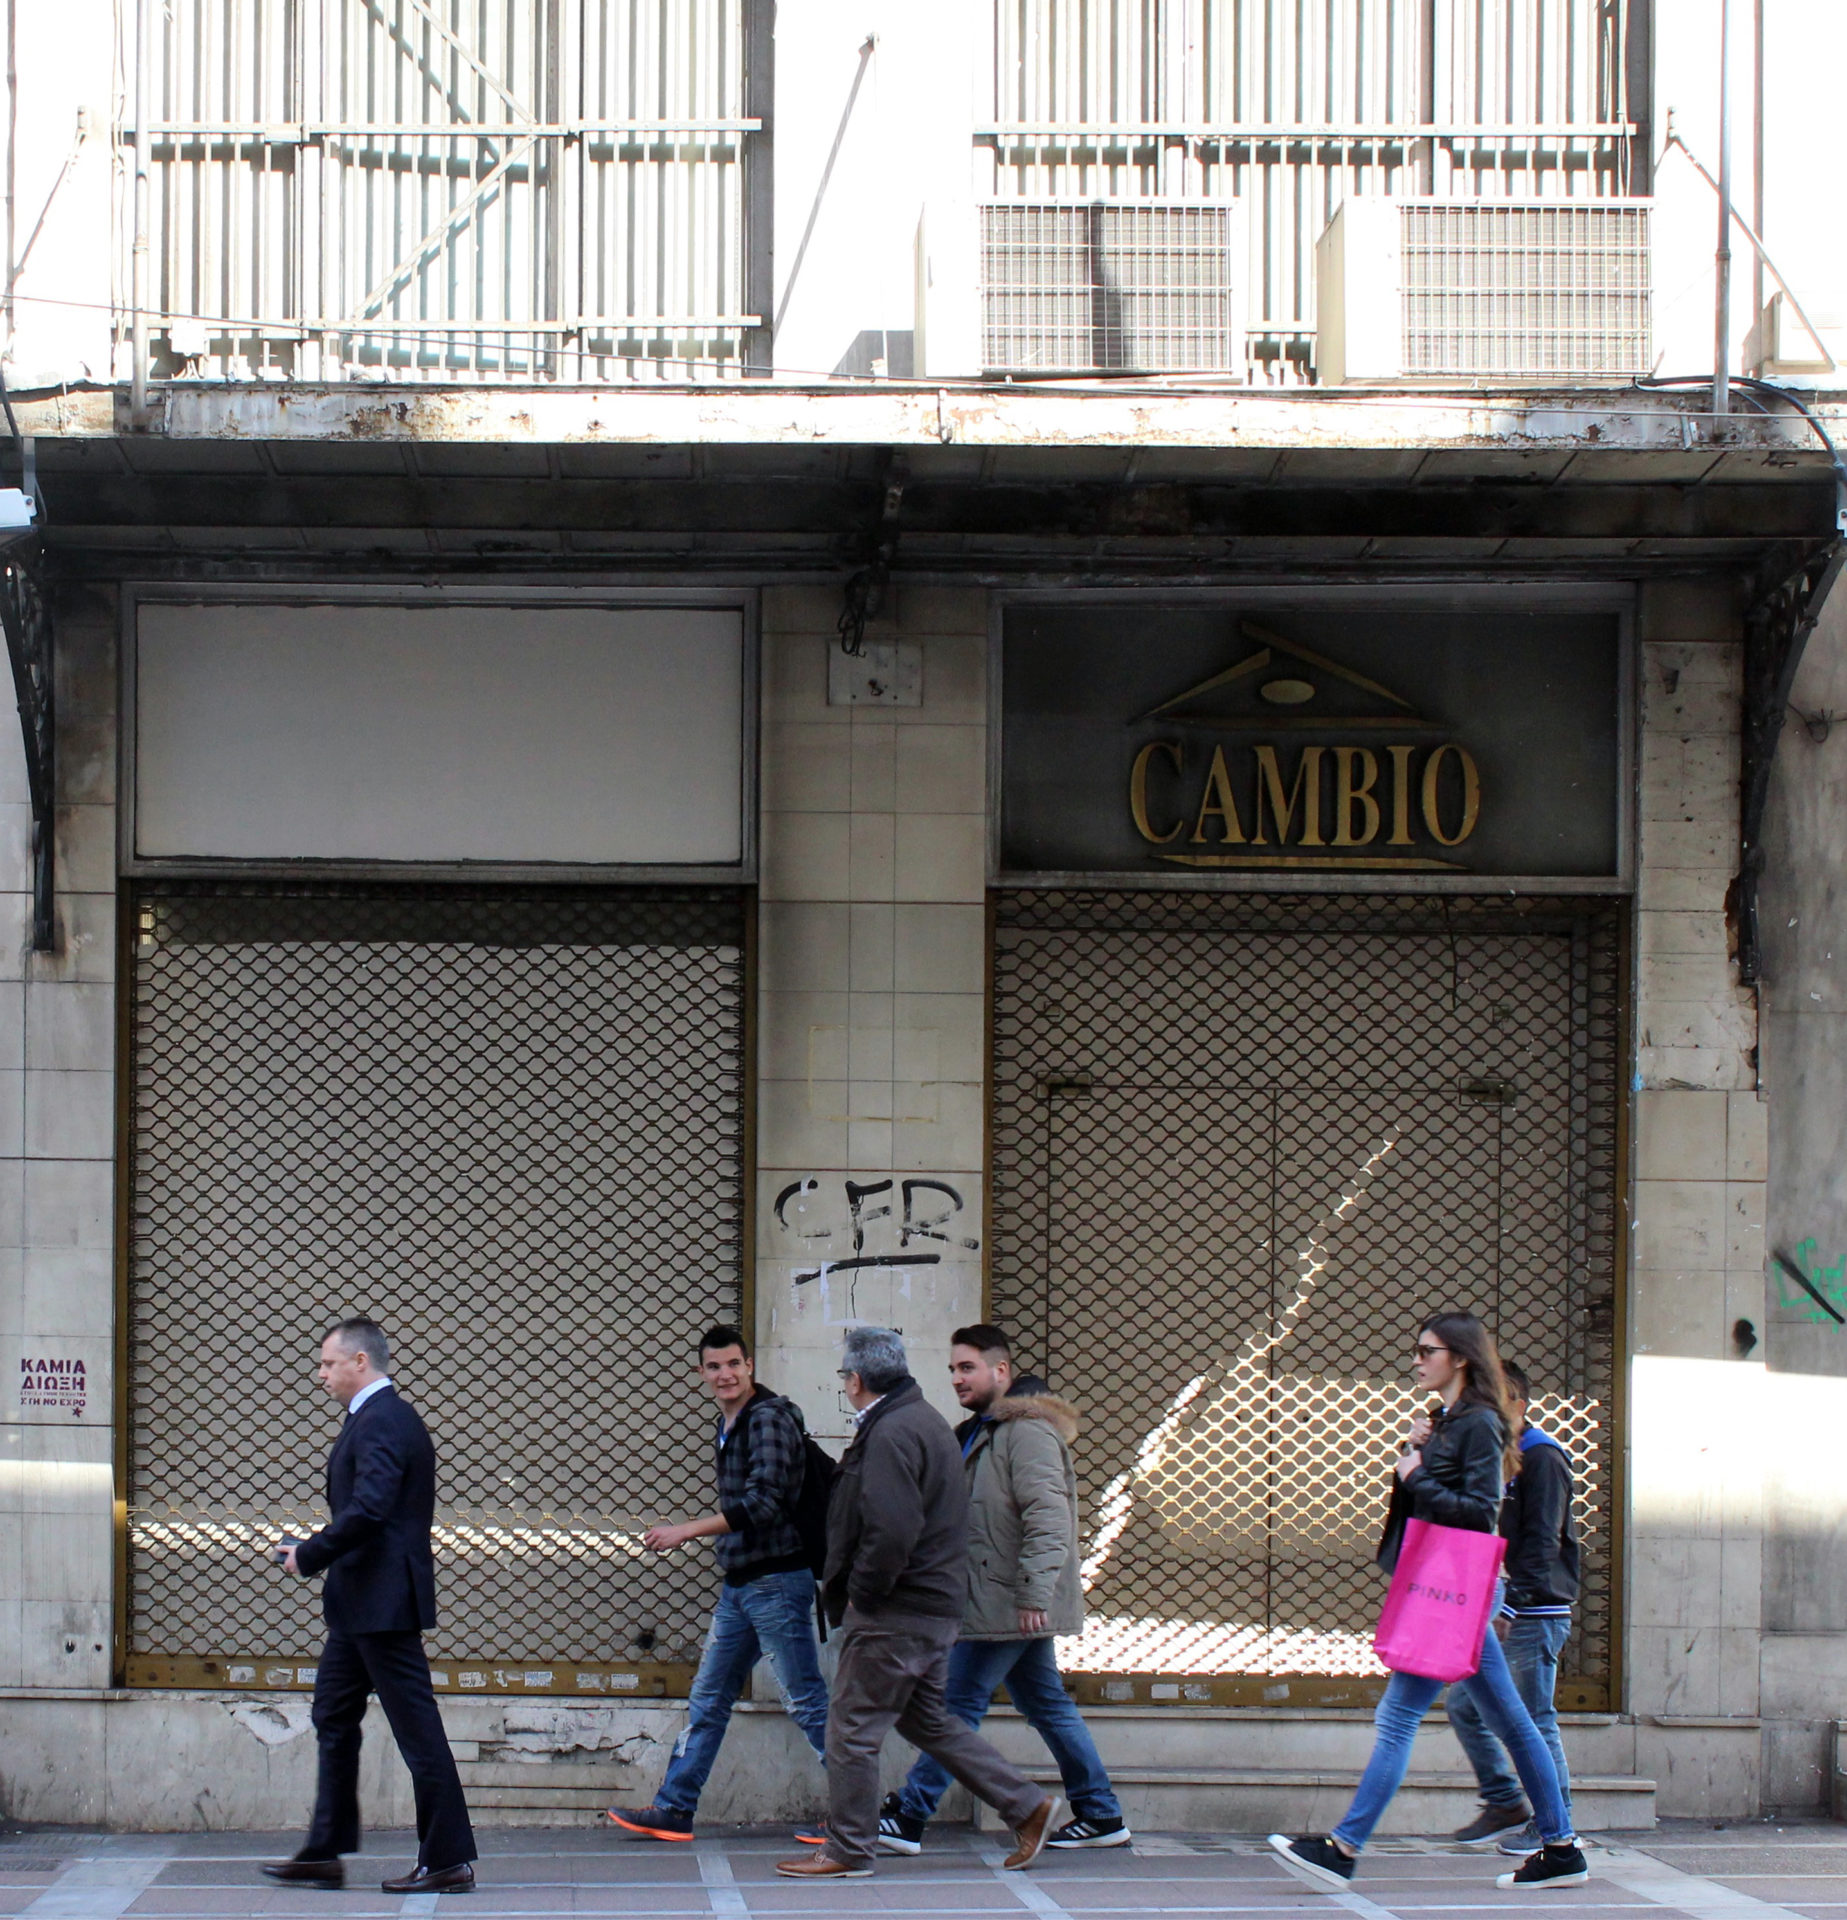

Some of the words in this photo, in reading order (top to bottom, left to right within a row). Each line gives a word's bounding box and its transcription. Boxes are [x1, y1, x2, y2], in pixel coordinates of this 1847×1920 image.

[1129, 740, 1481, 847] CAMBIO
[21, 1358, 87, 1375] ΚΑΜΙΑ
[21, 1375, 85, 1391] ΔΙΩΞΗ
[1408, 1583, 1467, 1606] PINKO
